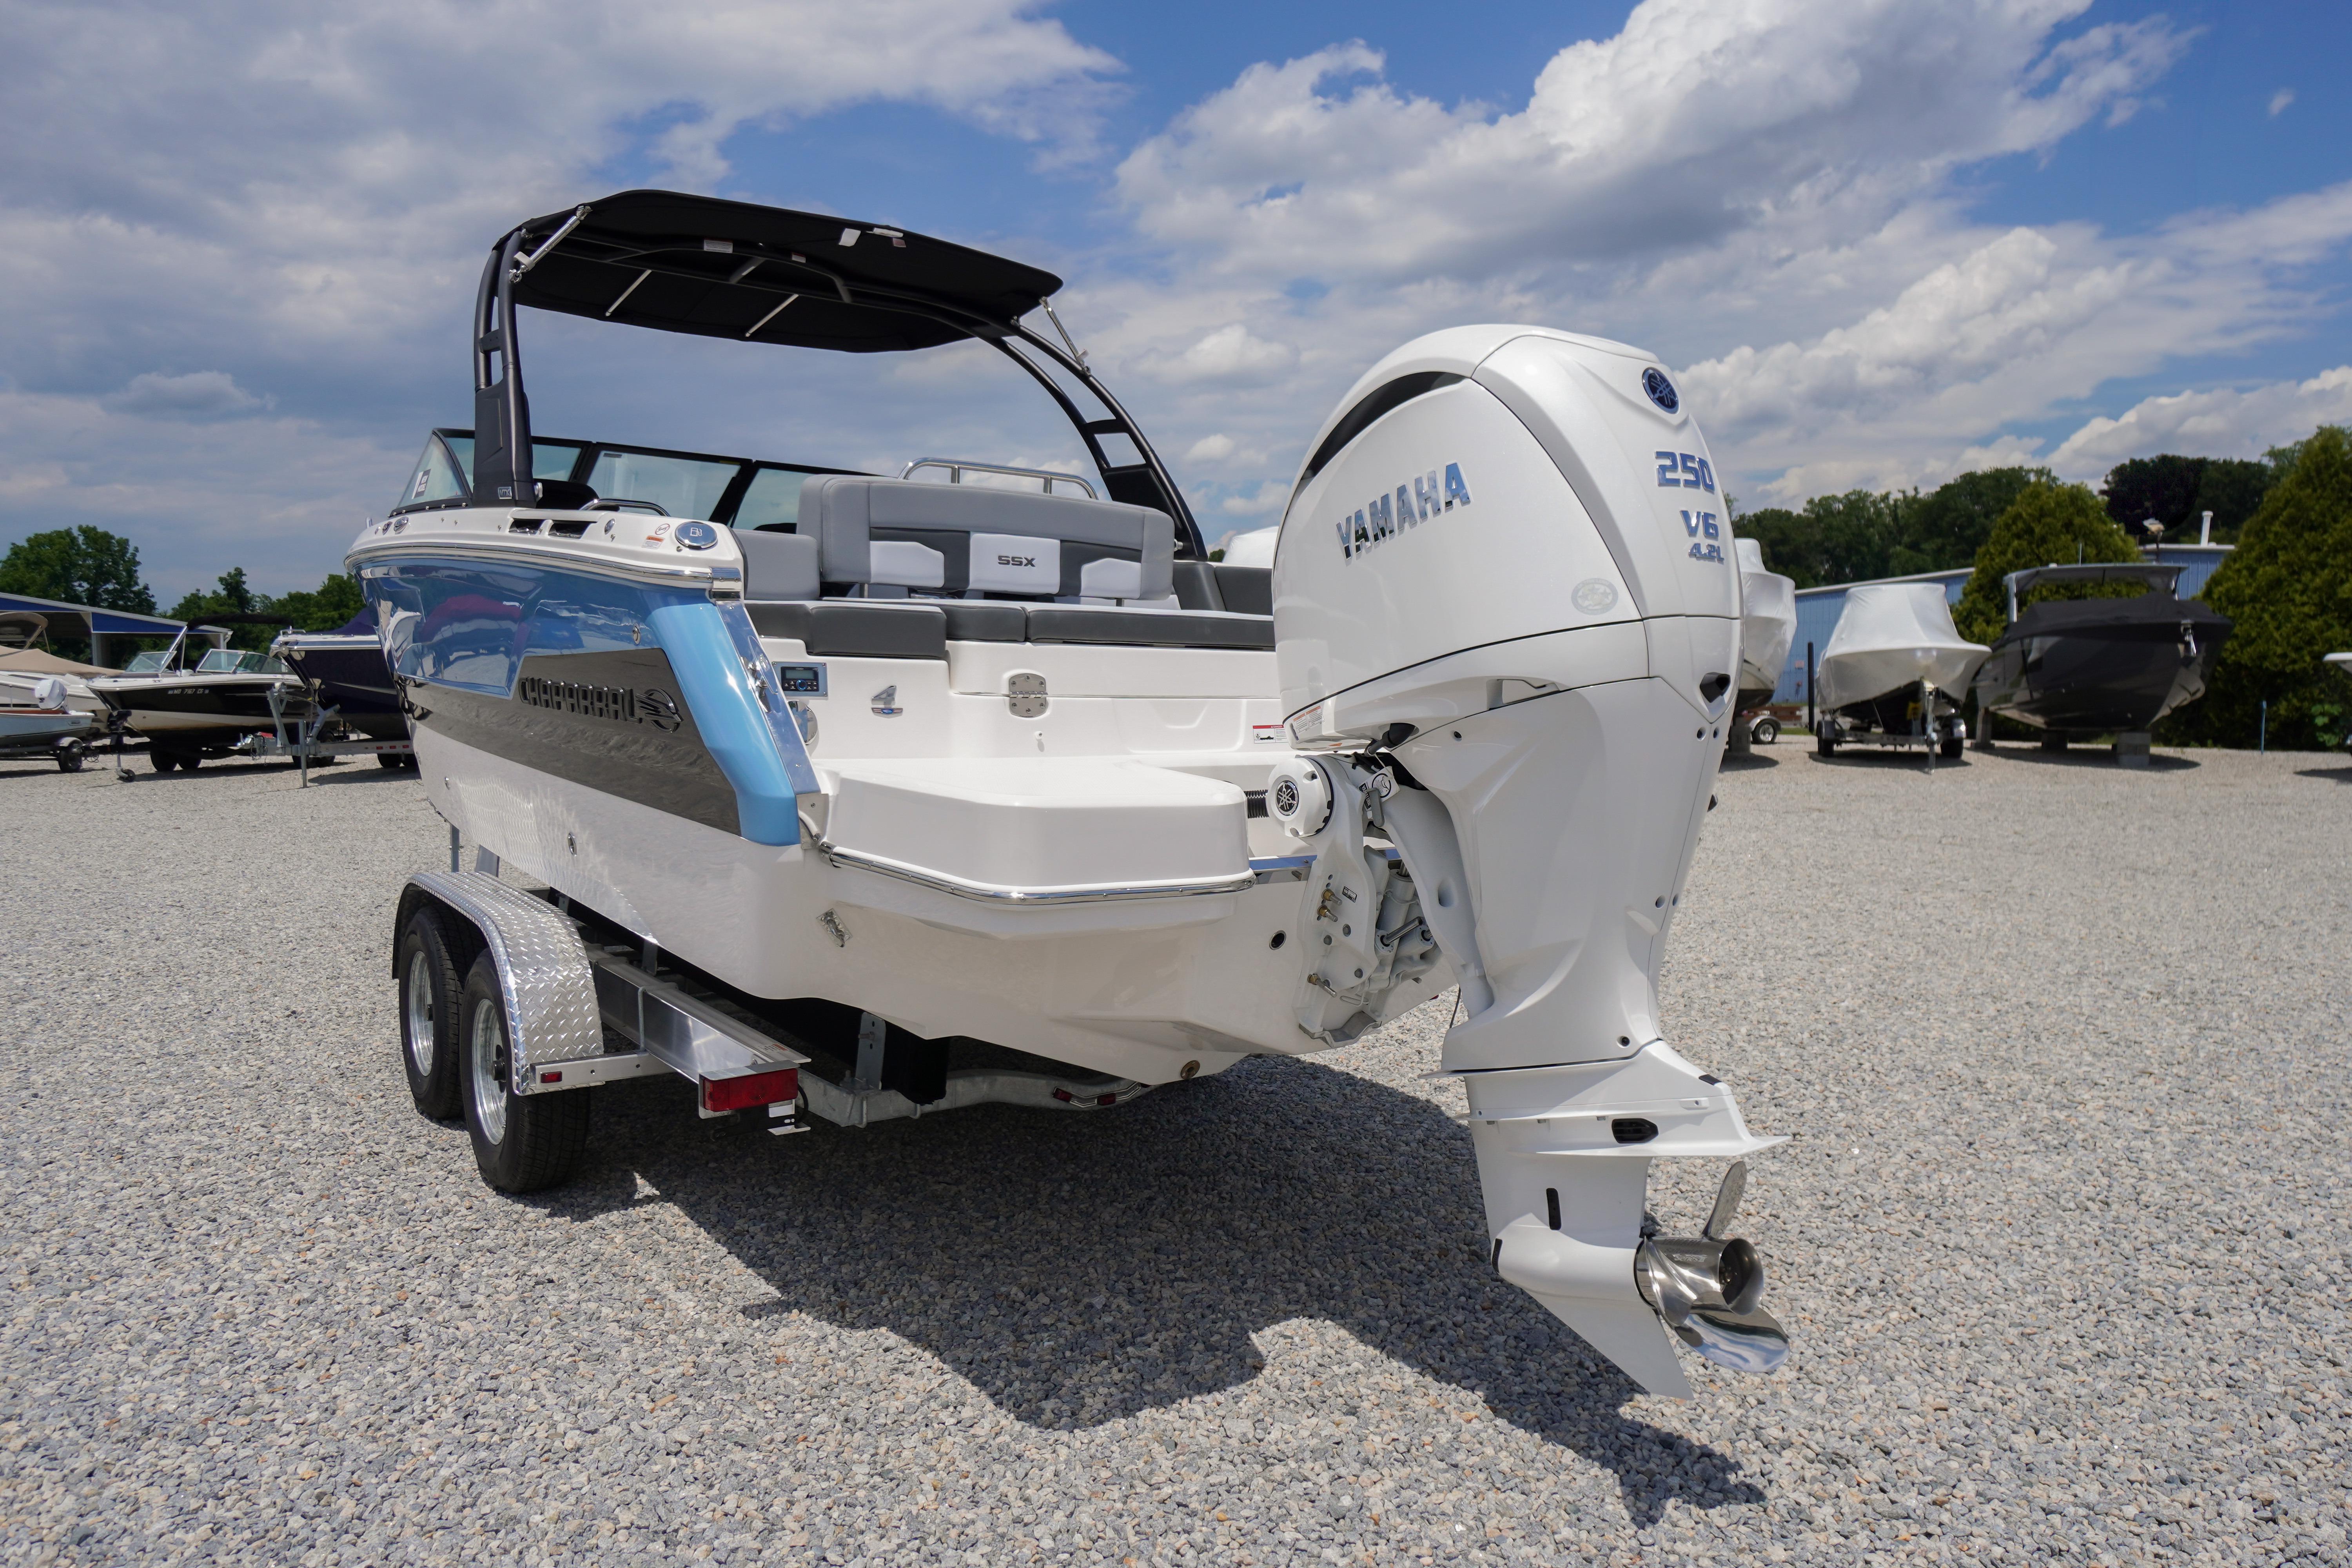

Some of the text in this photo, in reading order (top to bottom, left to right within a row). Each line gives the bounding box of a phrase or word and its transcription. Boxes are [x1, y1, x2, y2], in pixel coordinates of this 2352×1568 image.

[1655, 451, 1715, 494] 250
[1336, 462, 1471, 561] YAMAHA
[1680, 510, 1719, 541] V6
[998, 555, 1036, 567] SSX
[1688, 543, 1725, 564] 4.2L
[519, 676, 642, 724] CHAPARRAL
